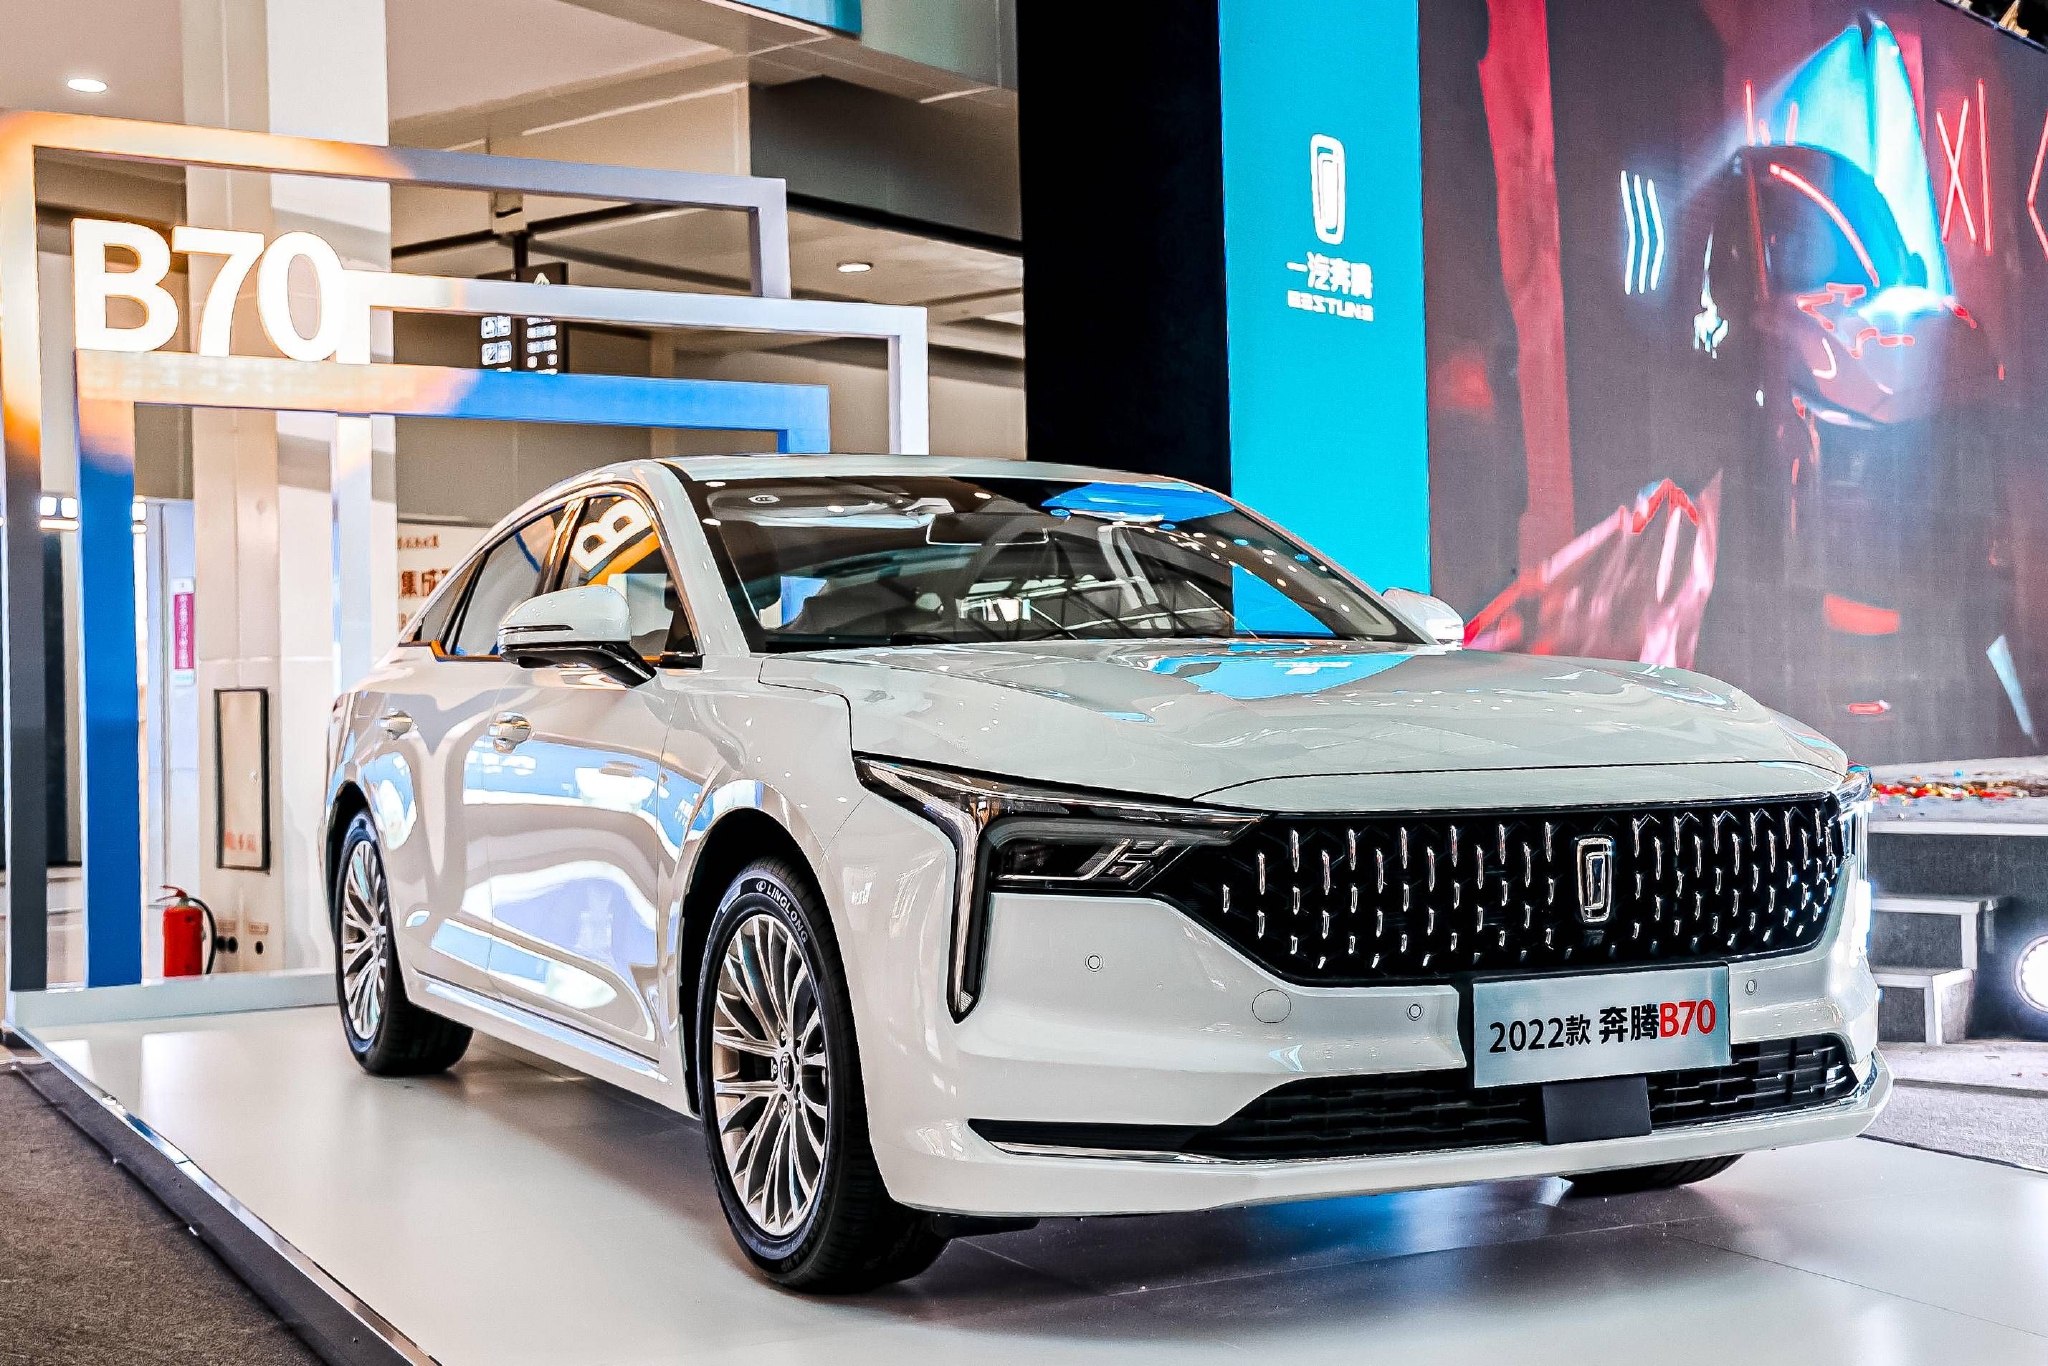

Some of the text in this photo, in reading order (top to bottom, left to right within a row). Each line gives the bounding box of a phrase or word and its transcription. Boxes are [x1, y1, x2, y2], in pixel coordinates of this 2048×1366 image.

[71, 217, 343, 362] B70
[766, 883, 809, 943] LINGLONG
[1489, 999, 1717, 1053] 2022款 奔腾B70
